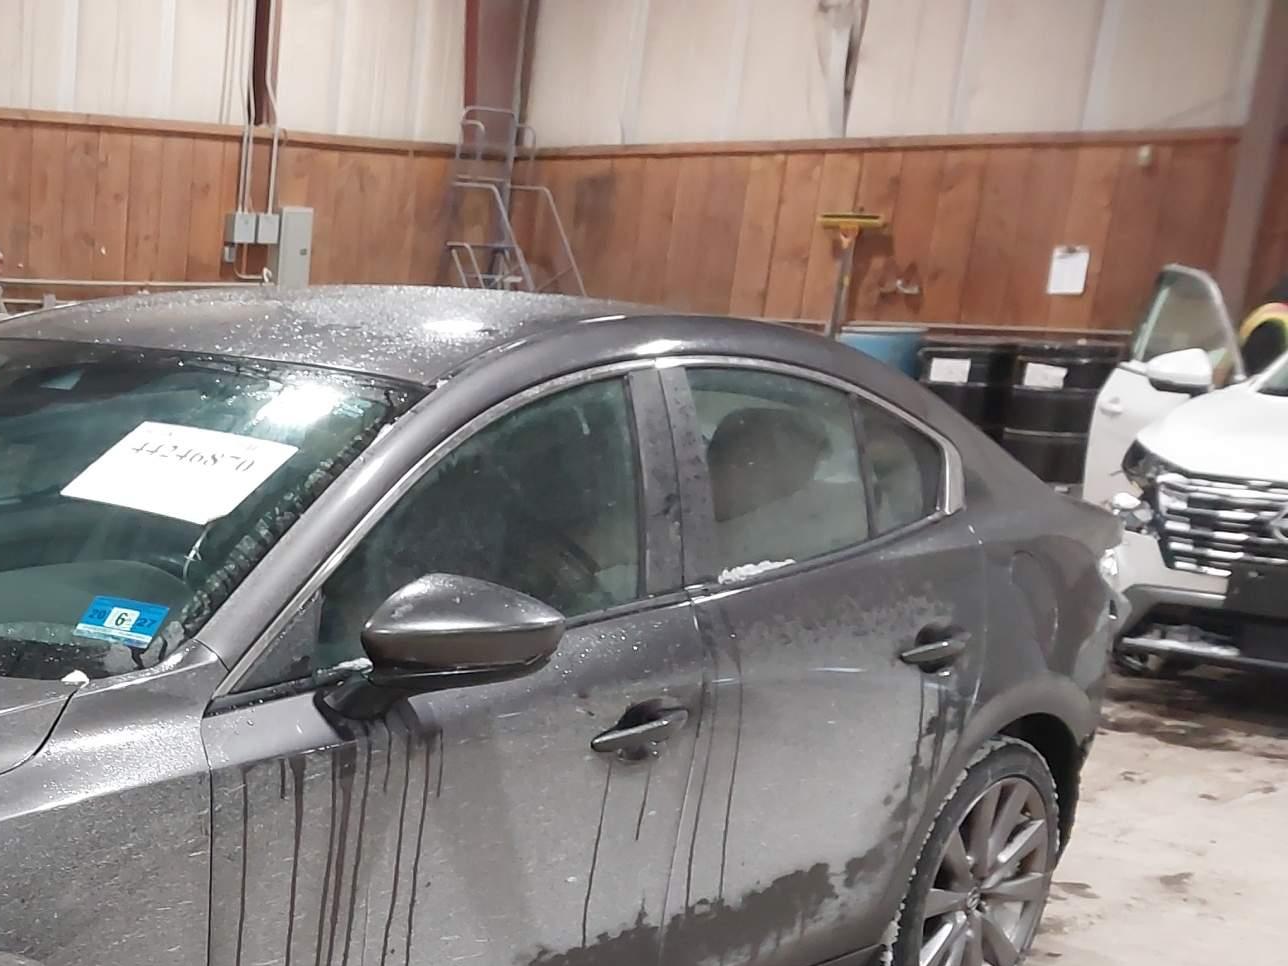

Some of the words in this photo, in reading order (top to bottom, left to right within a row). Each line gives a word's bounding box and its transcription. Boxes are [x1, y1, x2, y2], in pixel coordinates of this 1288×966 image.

[89, 608, 107, 620] 20
[114, 612, 129, 627] 6
[136, 617, 158, 628] 27
